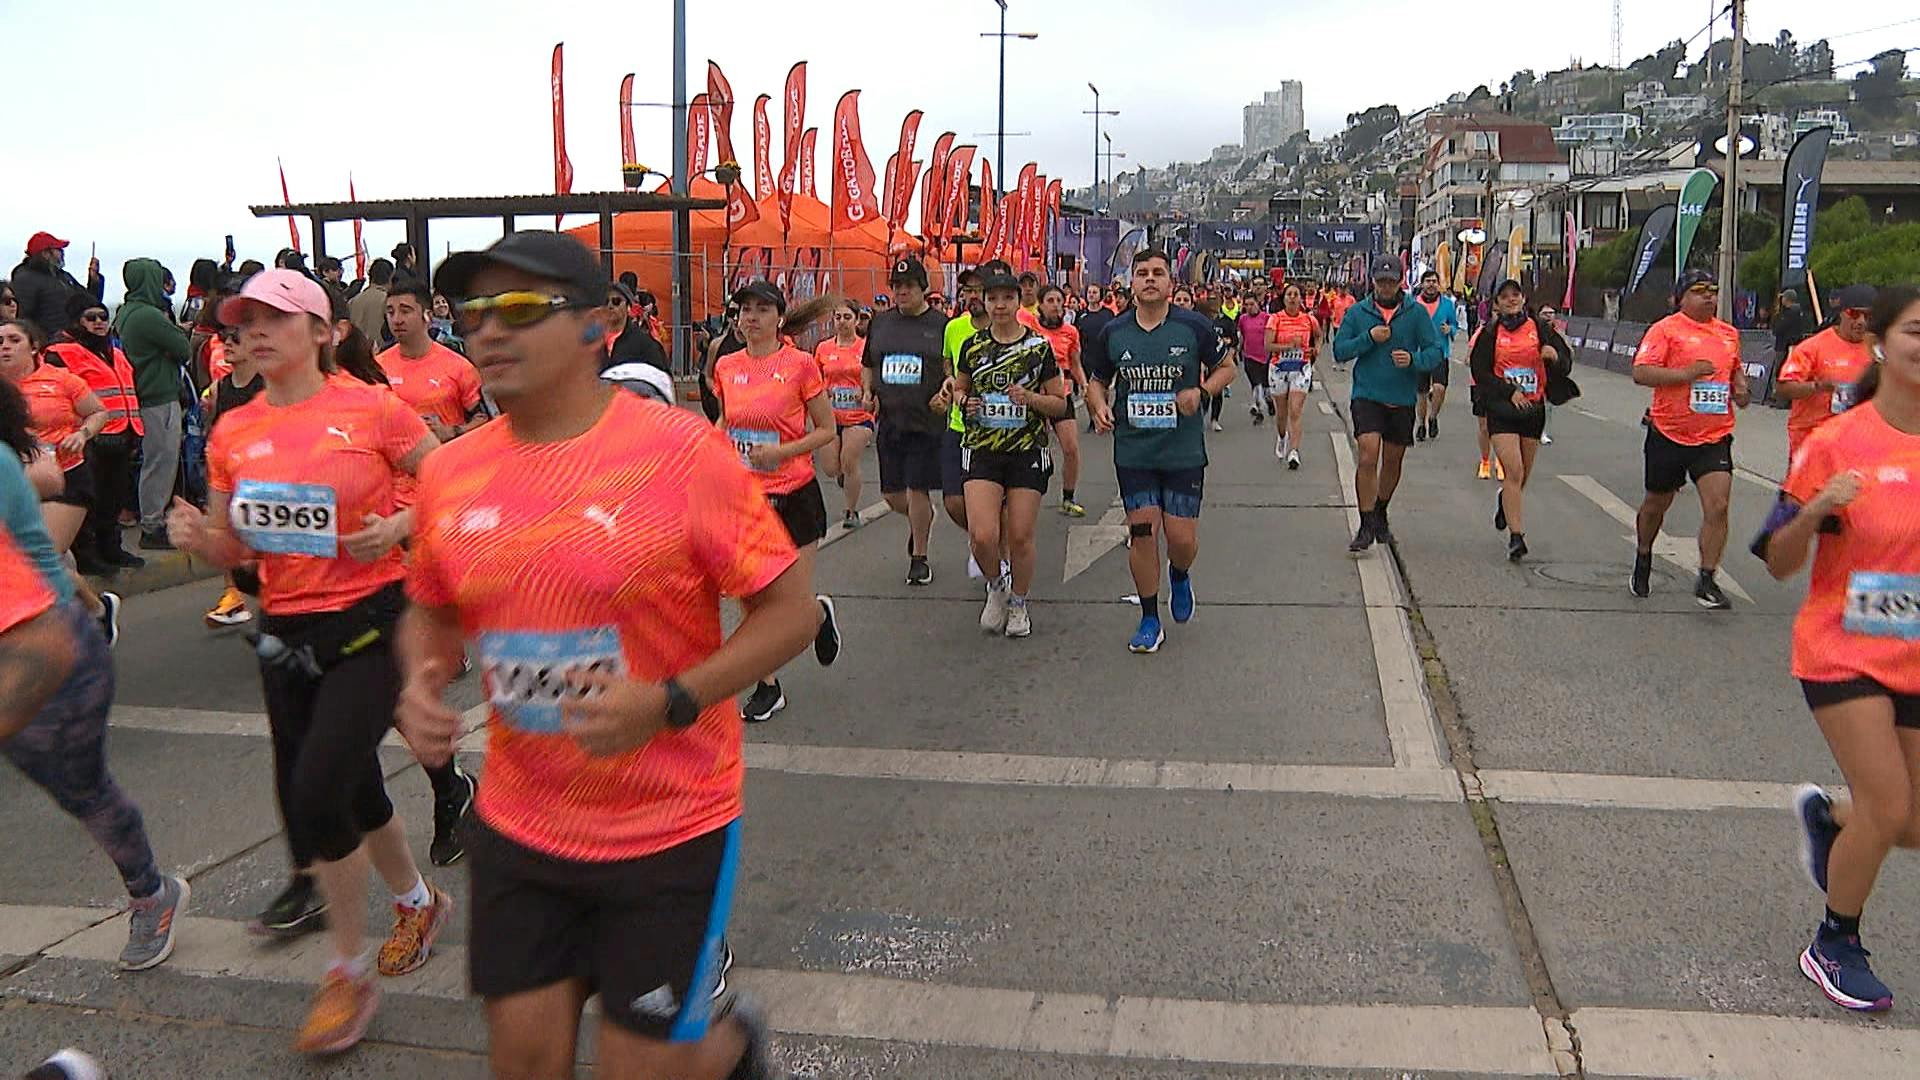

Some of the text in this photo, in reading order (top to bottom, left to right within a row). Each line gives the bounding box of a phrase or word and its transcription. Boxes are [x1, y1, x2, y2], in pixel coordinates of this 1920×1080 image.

[1788, 202, 1808, 269] PUMA
[884, 362, 919, 375] 11762
[1119, 363, 1183, 379] Emirates
[1142, 378, 1174, 391] BETTER
[1130, 403, 1174, 417] 13285
[238, 502, 330, 531] 13969
